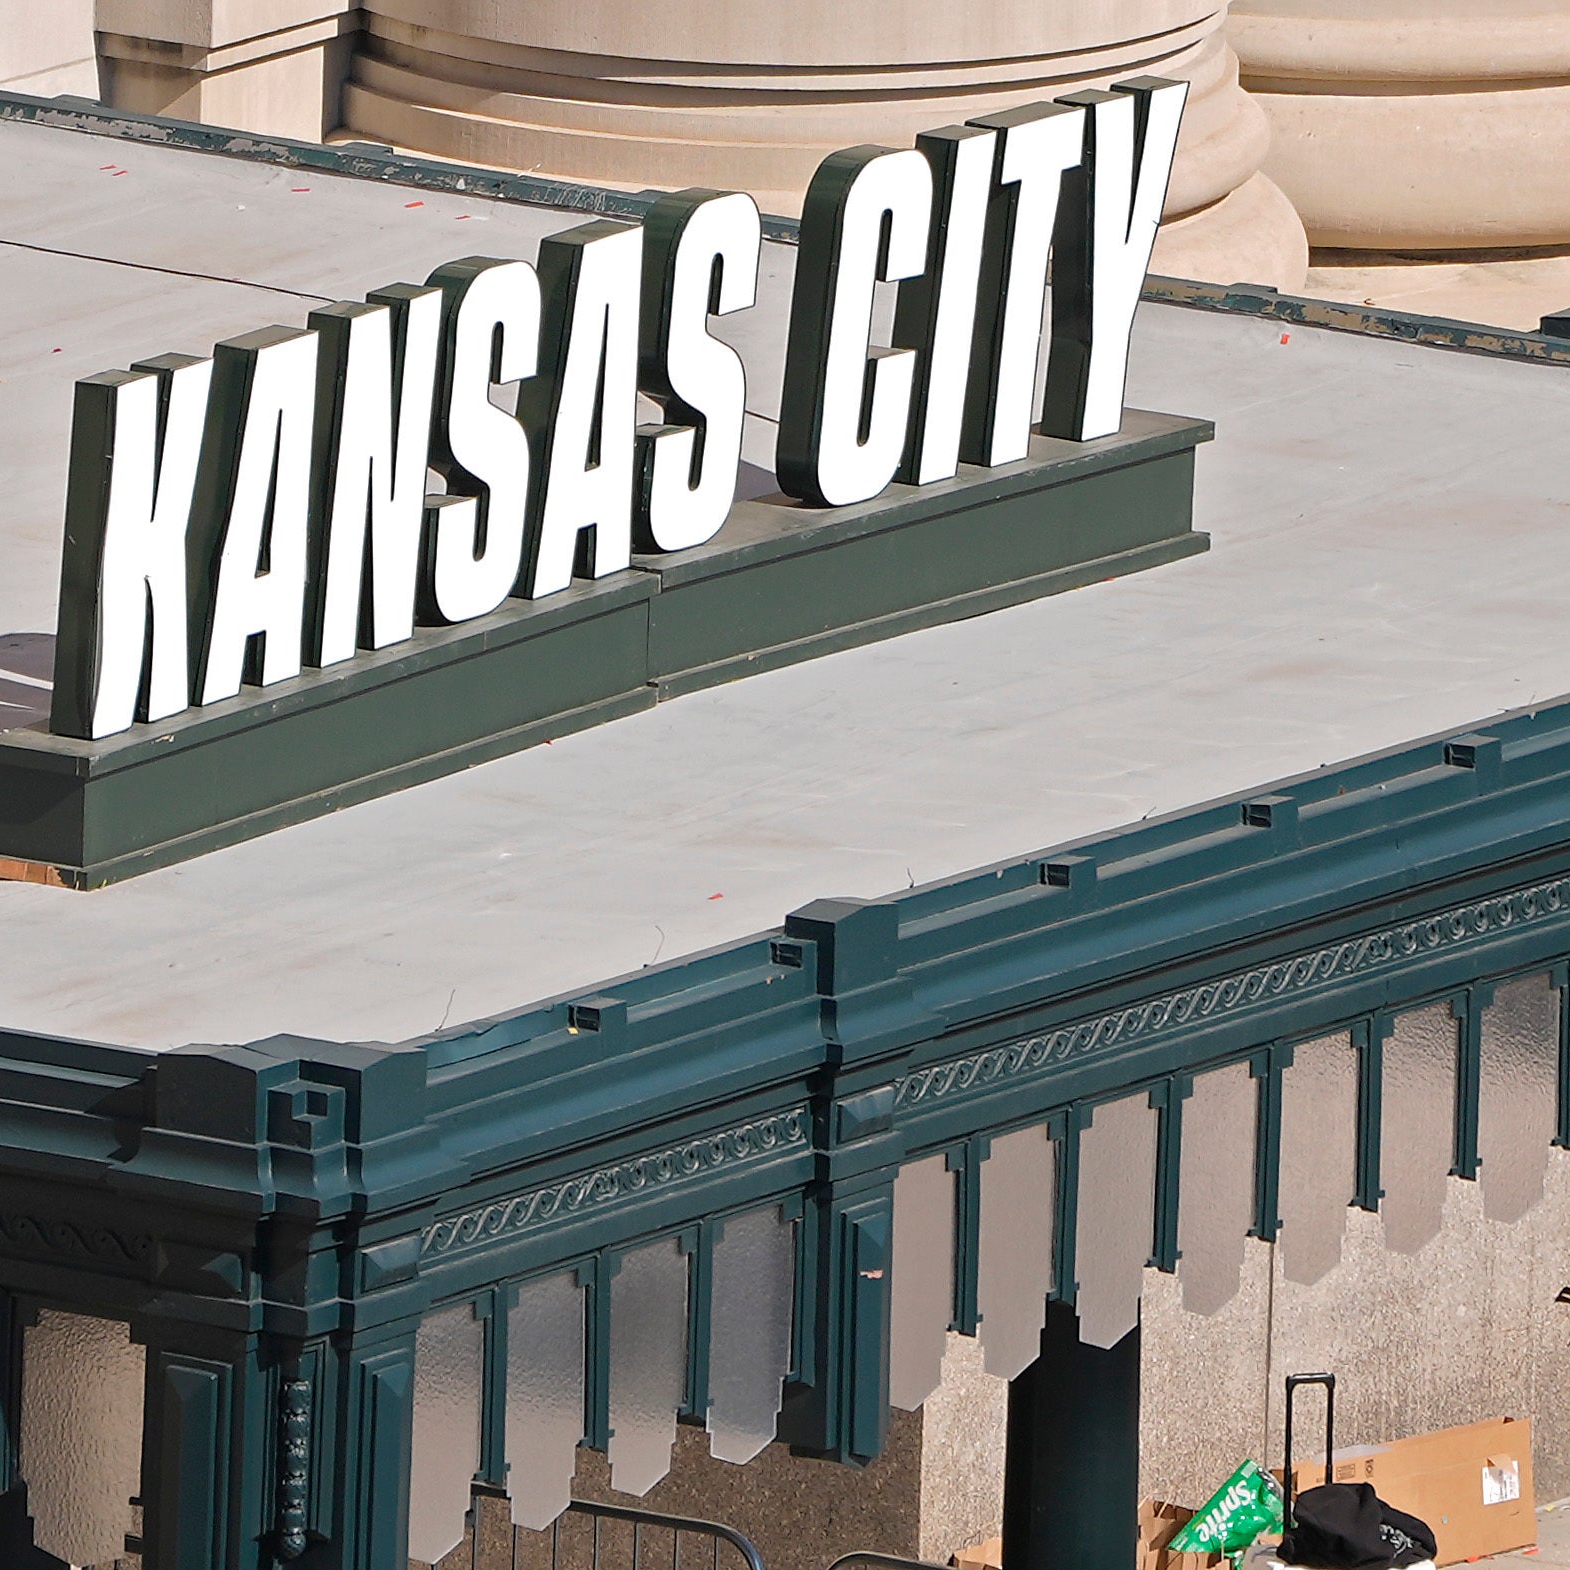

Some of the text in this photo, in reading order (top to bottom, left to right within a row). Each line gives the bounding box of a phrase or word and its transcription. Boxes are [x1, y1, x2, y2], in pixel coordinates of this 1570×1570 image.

[91, 79, 1188, 740] KANSAS CITY
[1194, 1479, 1251, 1543] Sprite
